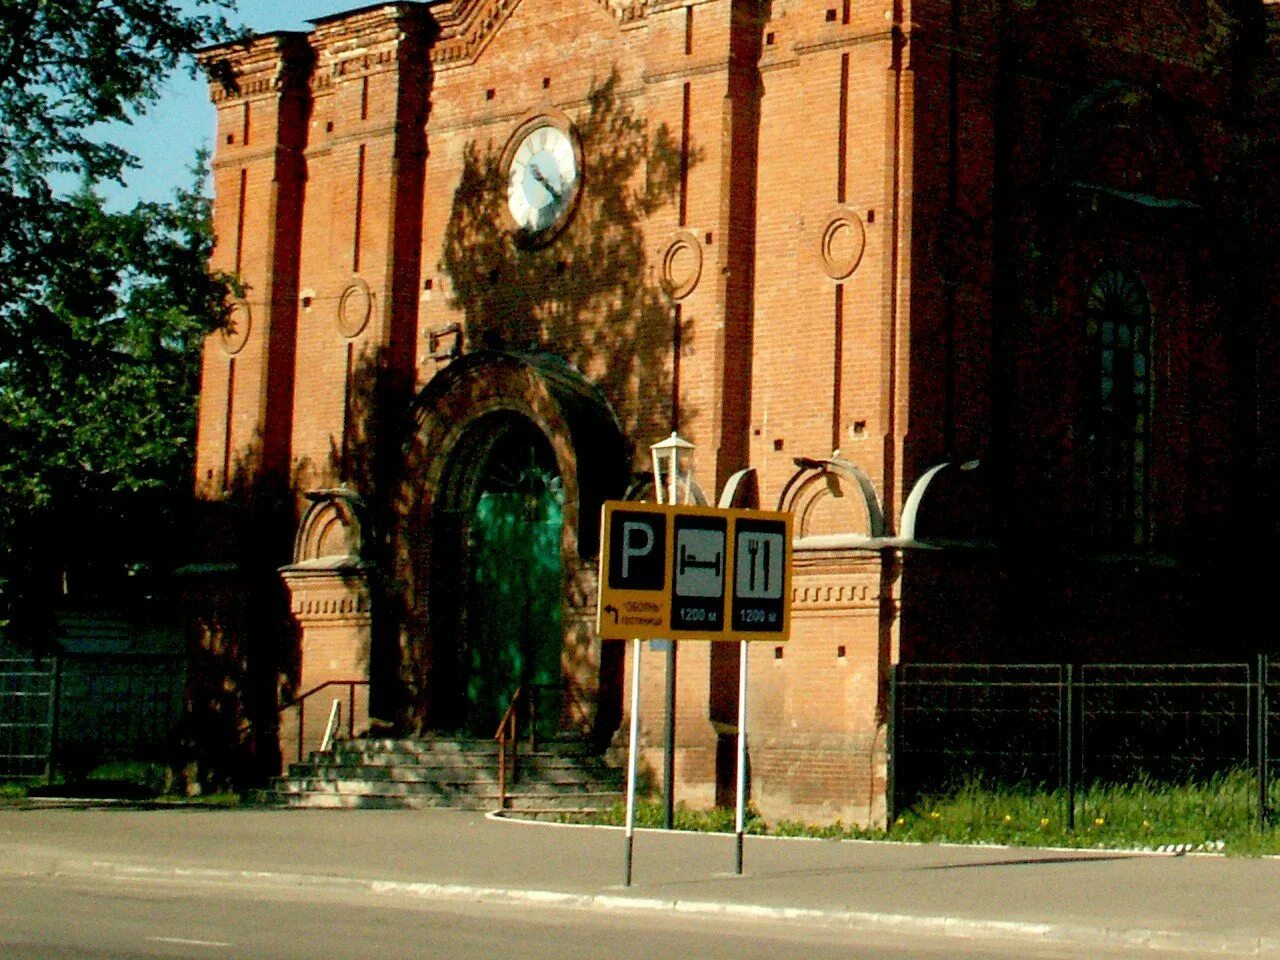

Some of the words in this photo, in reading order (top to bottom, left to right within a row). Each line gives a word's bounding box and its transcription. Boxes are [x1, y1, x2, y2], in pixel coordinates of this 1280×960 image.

[622, 522, 655, 578] P
[680, 608, 705, 621] 1200
[740, 609, 765, 622] 1200
